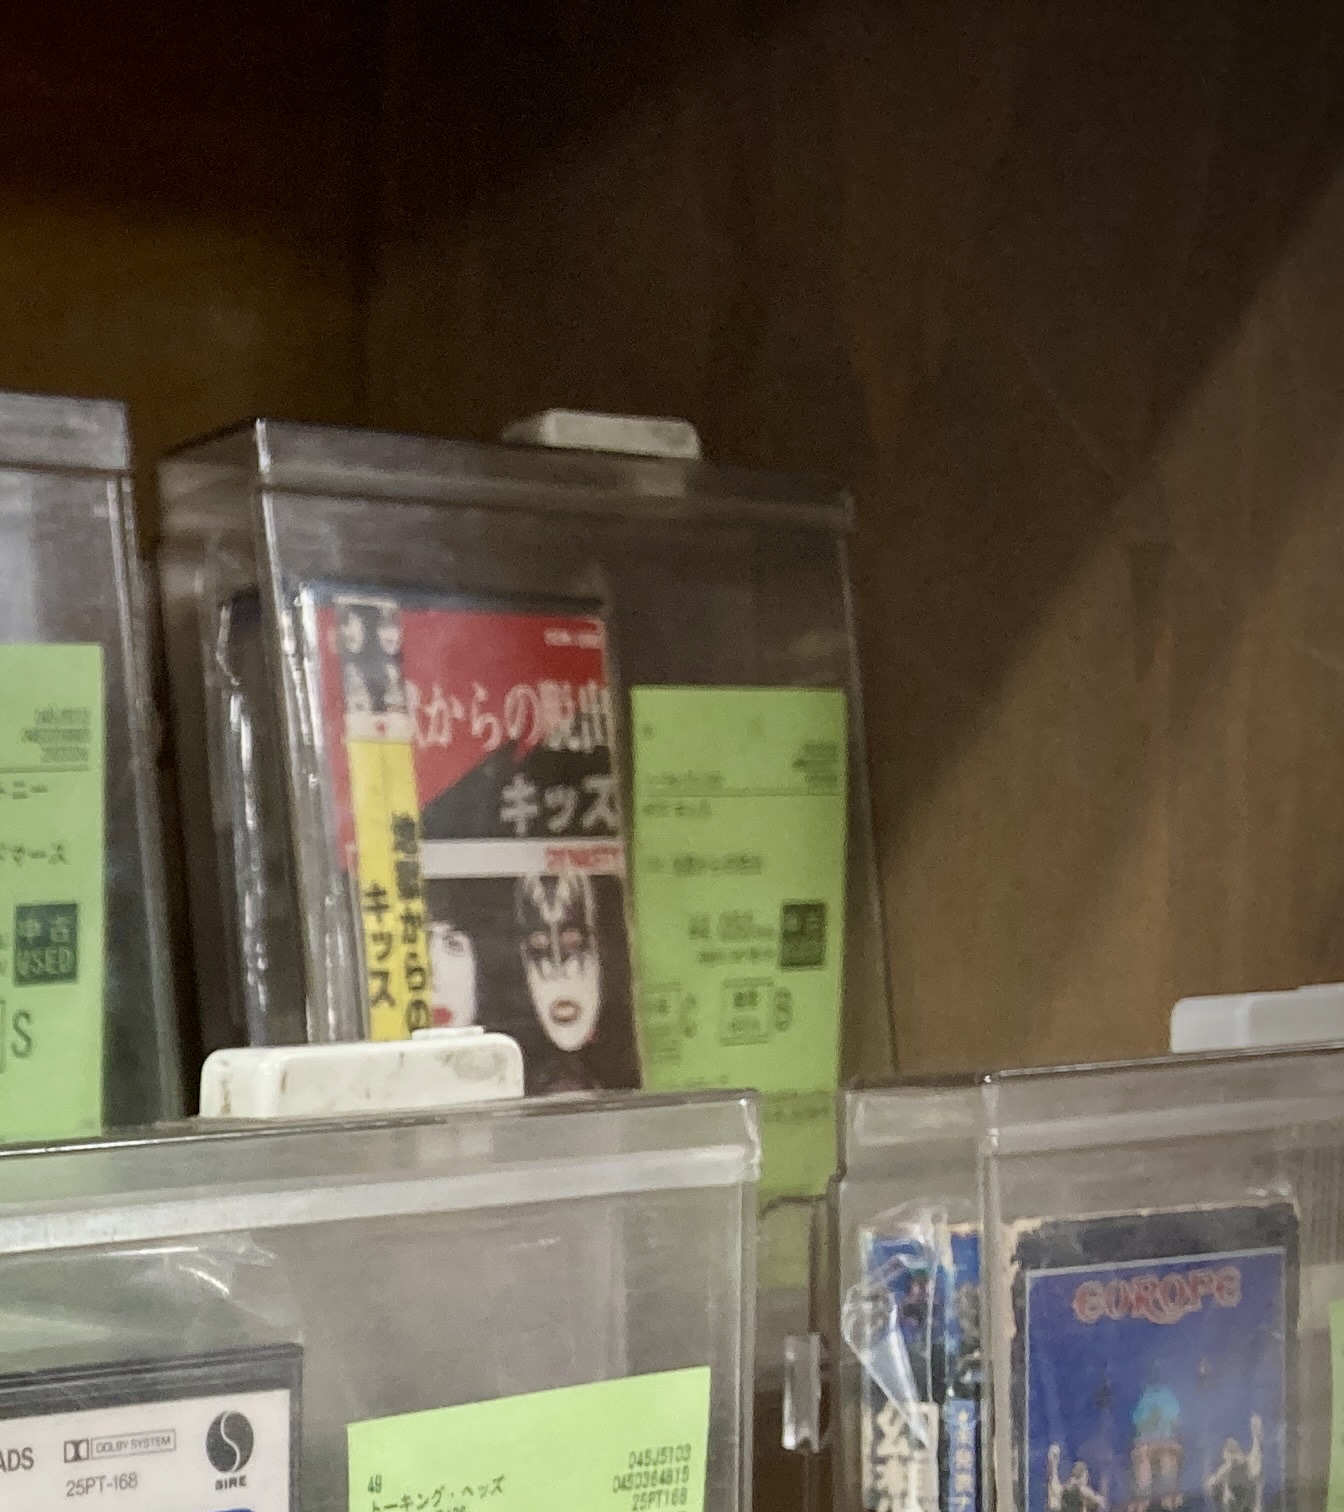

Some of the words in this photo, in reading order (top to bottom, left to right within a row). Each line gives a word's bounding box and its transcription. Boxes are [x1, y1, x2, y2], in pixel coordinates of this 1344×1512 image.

[499, 771, 620, 838] キッス
[10, 1009, 34, 1060] S
[65, 1471, 139, 1498] 25PT-168
[215, 1475, 247, 1490] SIRE
